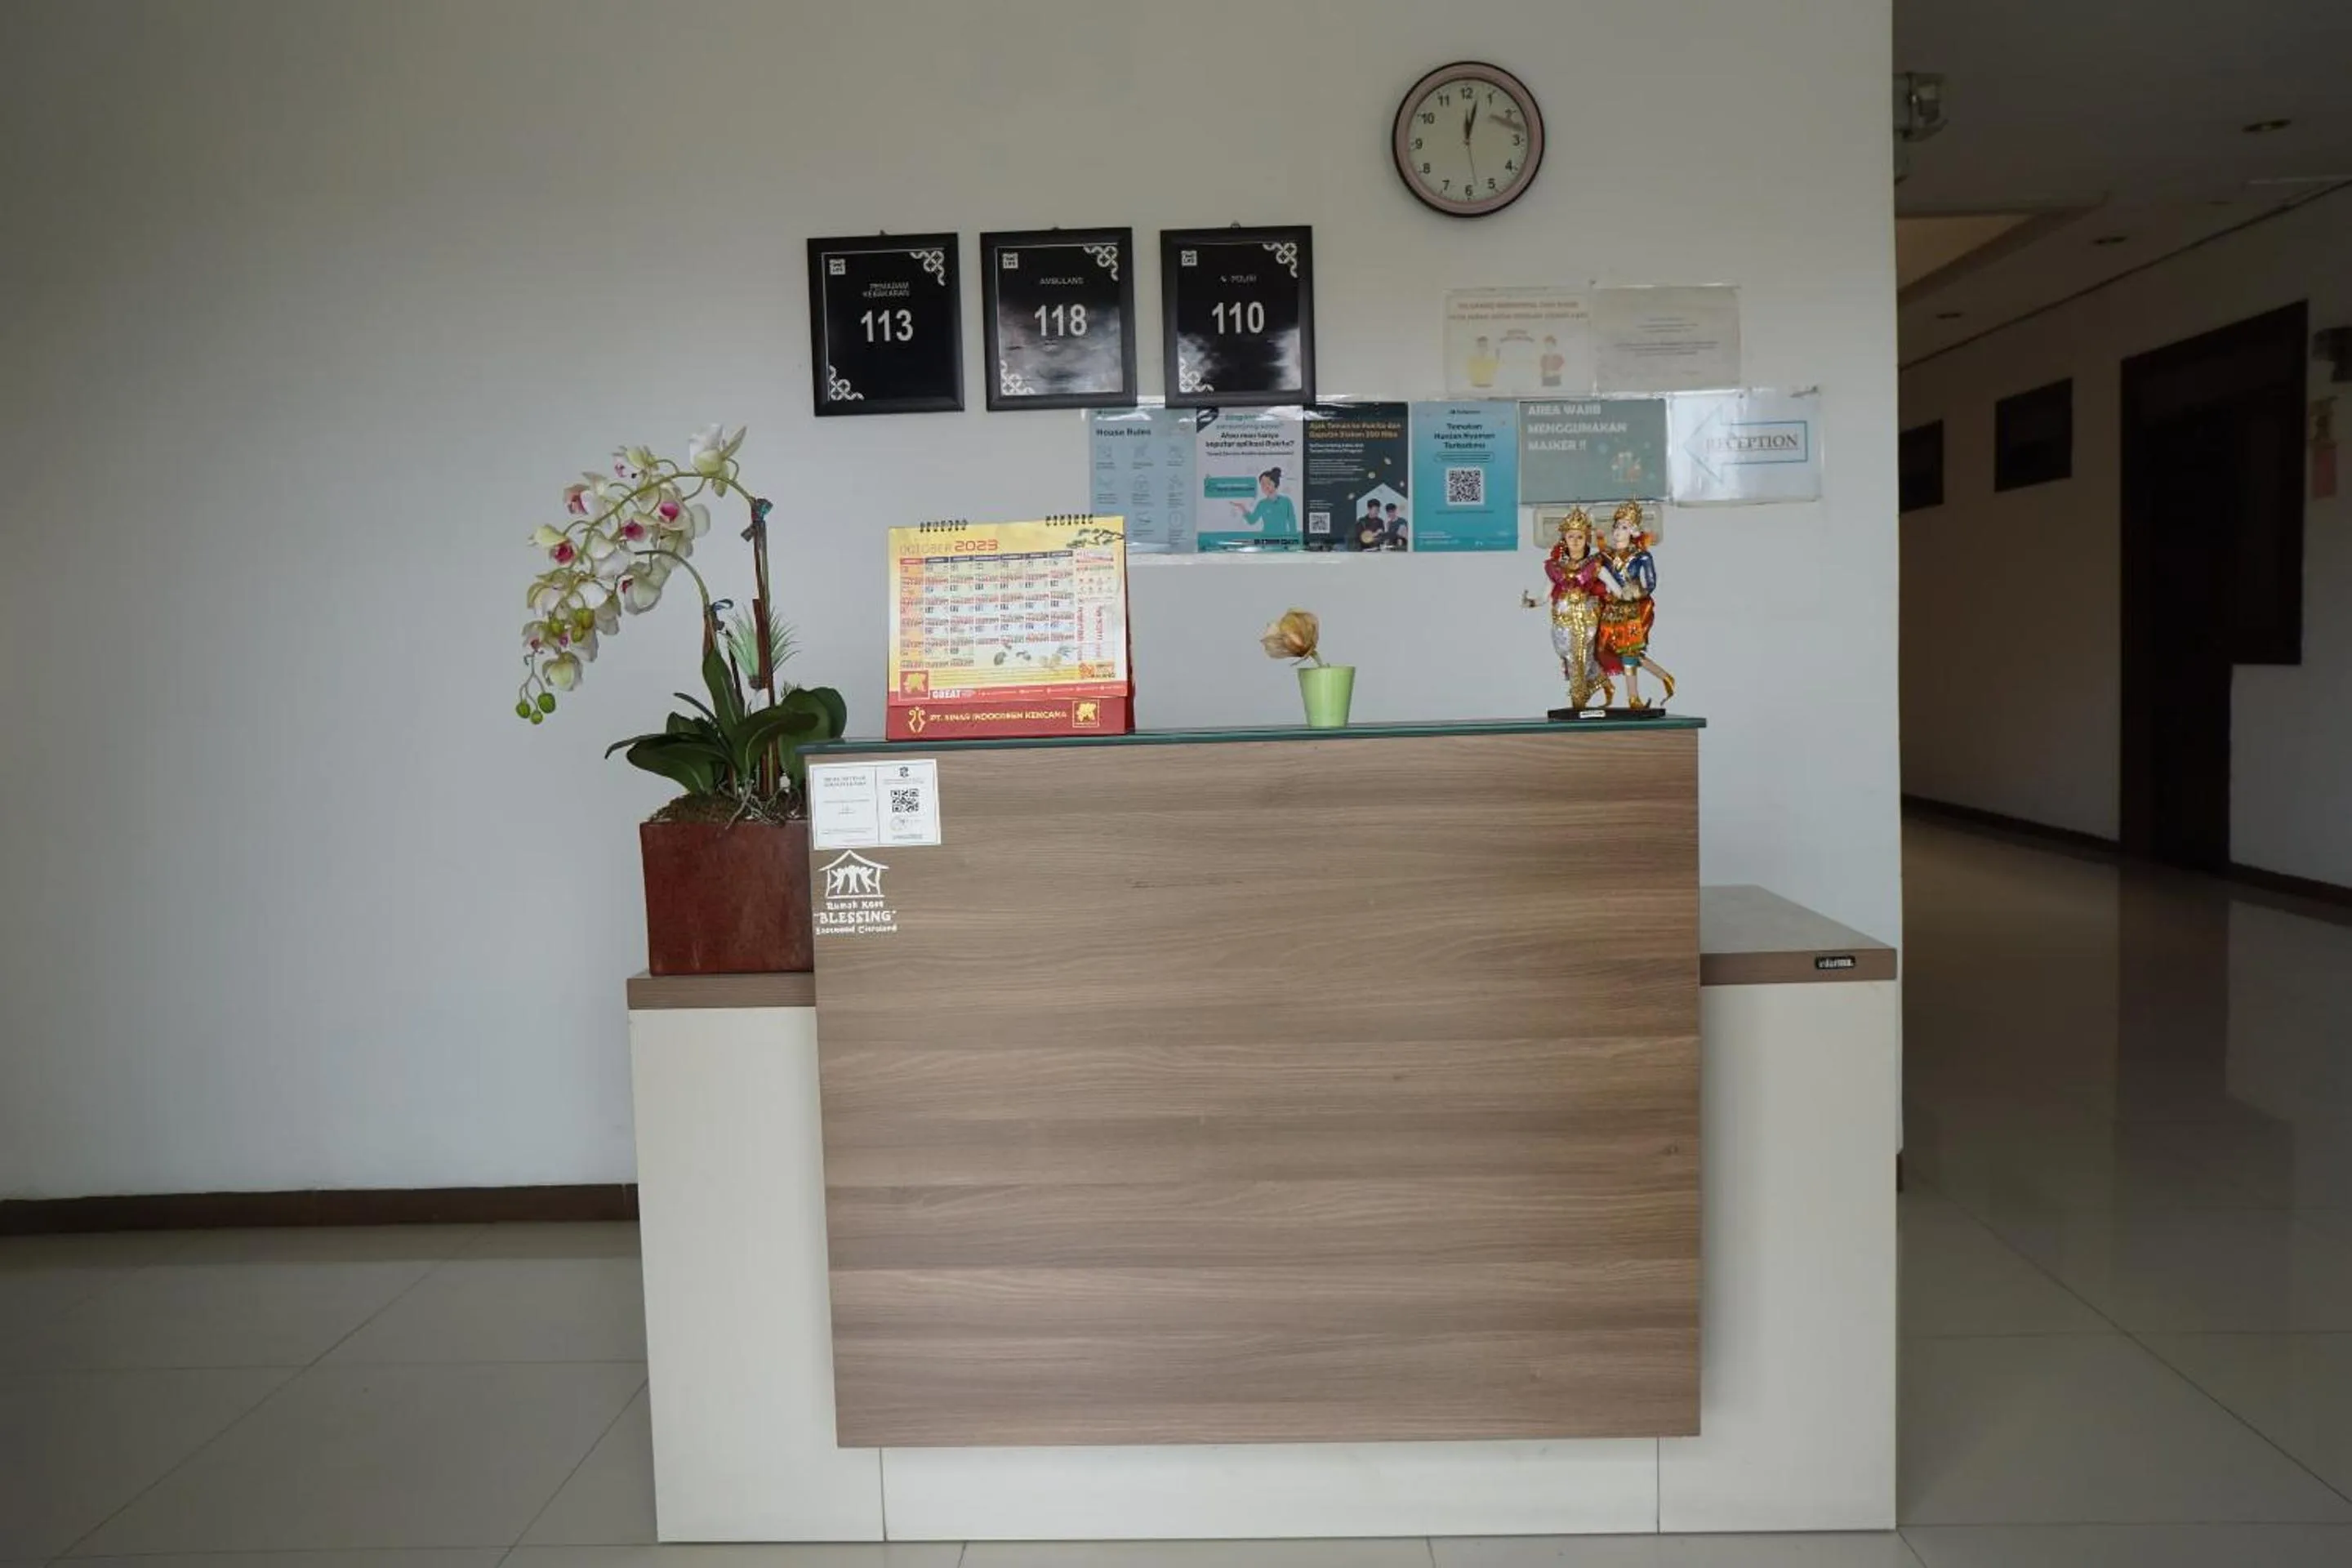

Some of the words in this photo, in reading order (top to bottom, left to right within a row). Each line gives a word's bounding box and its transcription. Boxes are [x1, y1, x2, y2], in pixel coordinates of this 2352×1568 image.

[1461, 87, 1473, 100] 12
[1437, 96, 1450, 107] 11
[1487, 94, 1493, 107] 1
[1422, 113, 1435, 124] 10
[1414, 138, 1423, 149] 9
[1512, 134, 1521, 146] 3
[1423, 163, 1431, 174] 8
[1504, 158, 1513, 171] 4
[1442, 179, 1450, 190] 7
[1487, 178, 1496, 189] 5
[1465, 185, 1473, 196] 6
[1034, 304, 1087, 336] 118
[1211, 301, 1265, 335] 110
[860, 309, 914, 342] 113
[1095, 428, 1125, 436] House
[1527, 422, 1628, 434] MENGGUNAKAN
[954, 539, 999, 552] 2023
[826, 901, 858, 911] Rumah
